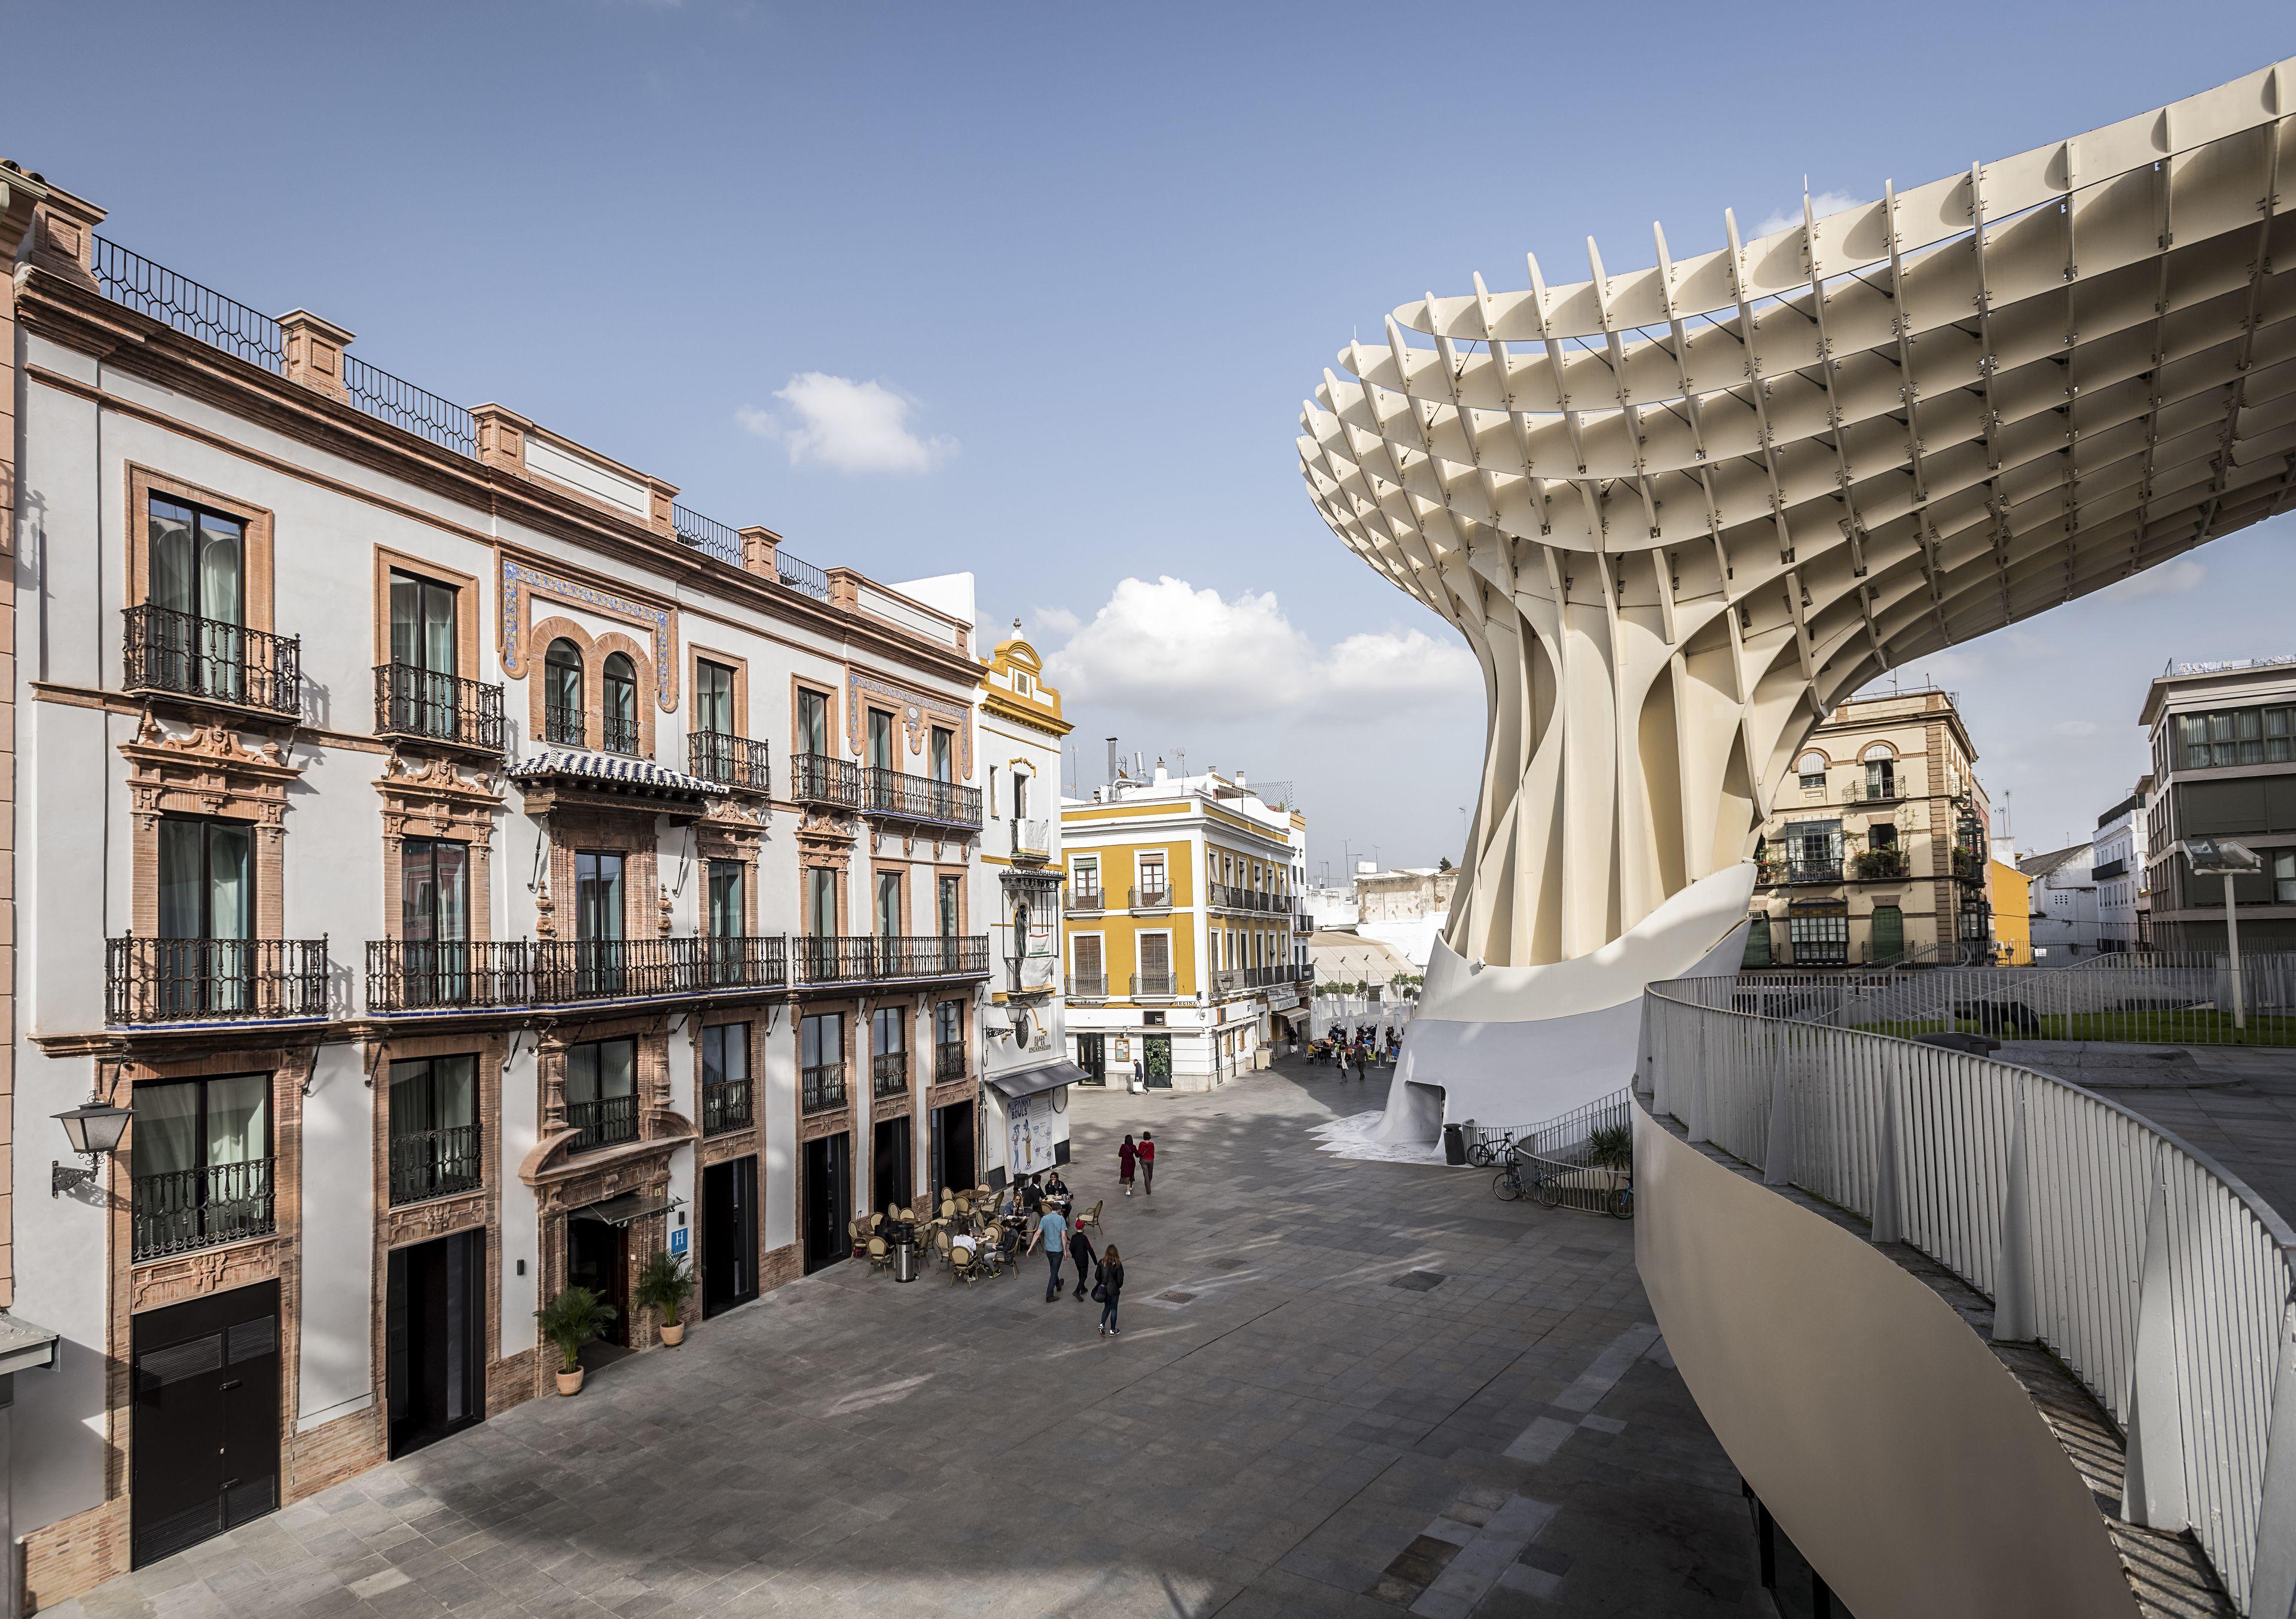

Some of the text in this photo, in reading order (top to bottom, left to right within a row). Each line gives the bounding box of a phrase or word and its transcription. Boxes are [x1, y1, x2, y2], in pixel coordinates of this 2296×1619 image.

[1007, 1096, 1031, 1113] MUPANKY
[1012, 1107, 1027, 1119] BOWLS
[676, 1231, 684, 1246] H
